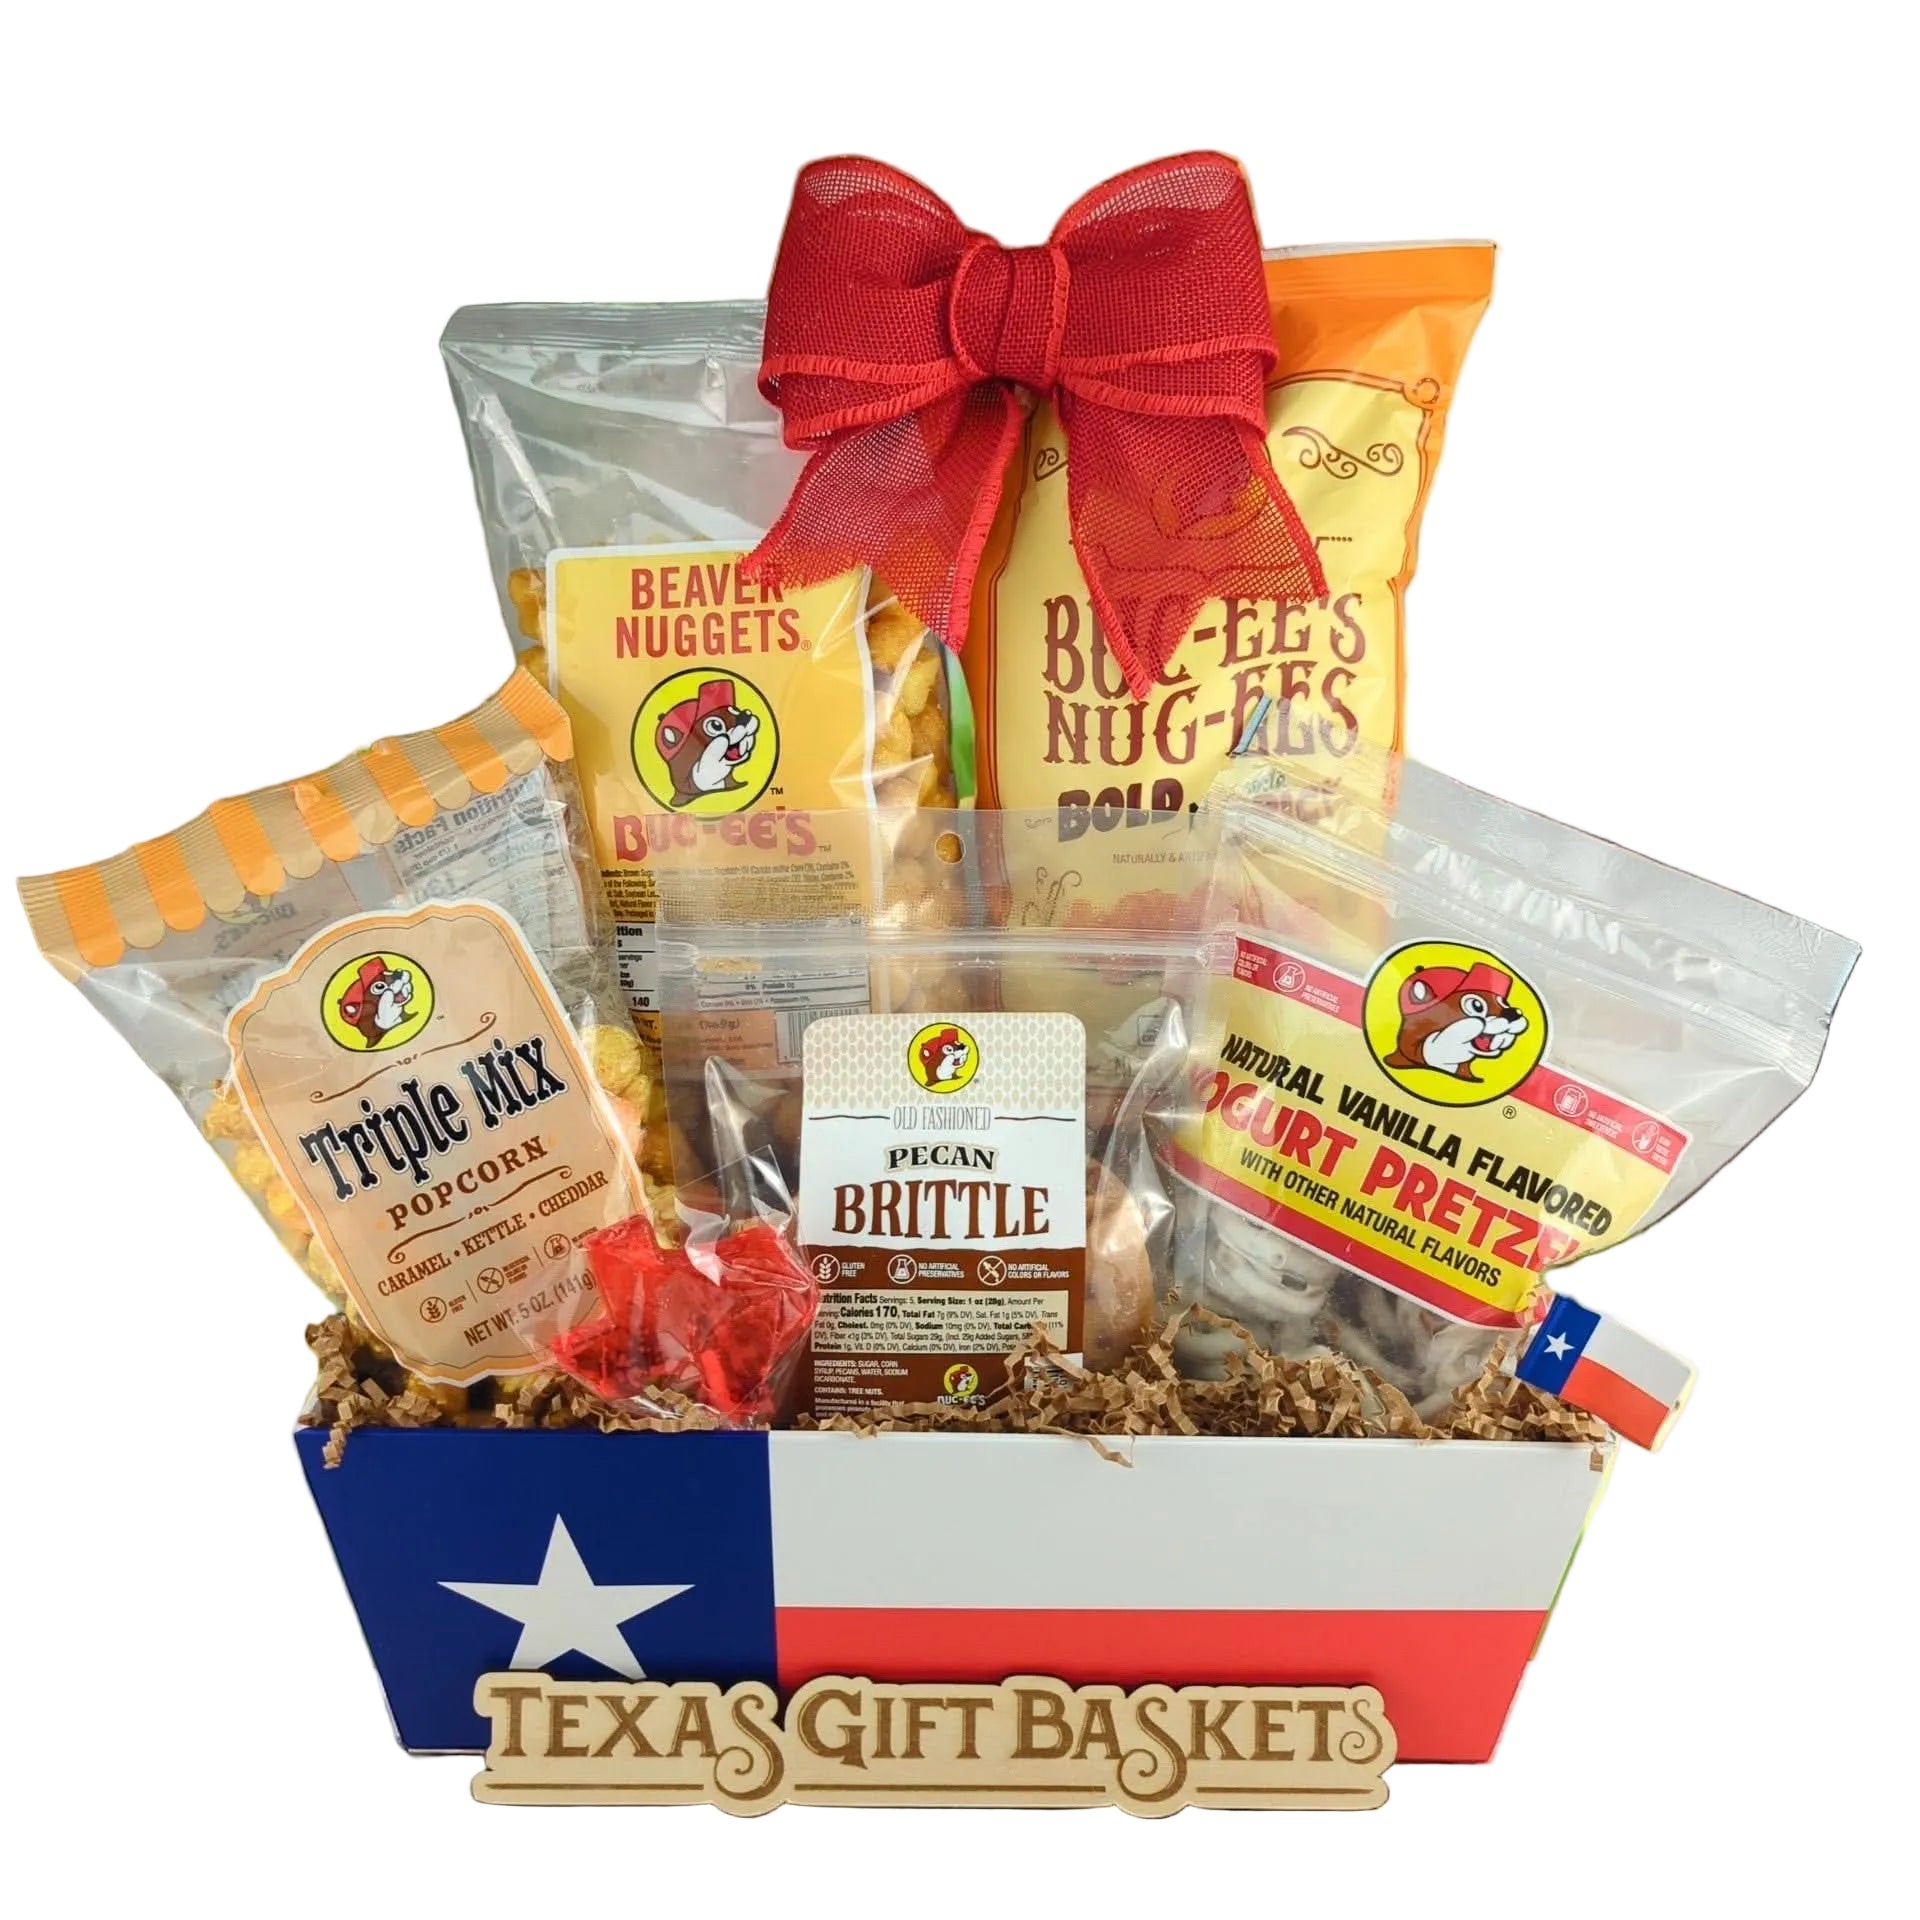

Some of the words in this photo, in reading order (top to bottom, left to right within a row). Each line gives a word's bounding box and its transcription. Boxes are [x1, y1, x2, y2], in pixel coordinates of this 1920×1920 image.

[632, 563, 783, 610] BEAVER
[1042, 661, 1358, 766] NUG-EES
[613, 806, 816, 862] BUC-EE'S
[1058, 778, 1184, 842] BOLD
[1113, 852, 1166, 865] NATURALLY
[632, 997, 649, 1007] 140
[298, 1077, 470, 1200] Triple
[893, 1106, 917, 1130] OLD
[922, 1106, 991, 1131] FASHIONED
[1220, 1034, 1325, 1105] NATURAL
[1337, 1085, 1462, 1168] VANILLA
[1466, 1147, 1613, 1237] FLAVORED
[386, 1135, 549, 1231] POPCORN
[888, 1145, 995, 1170] PECAN
[377, 1253, 452, 1297] CARAMEL
[461, 1212, 528, 1257] KETTLE
[537, 1170, 609, 1217] CHEDDAR
[832, 1179, 1050, 1239] BRITTLE
[1240, 1147, 1284, 1184] WITH
[1284, 1170, 1340, 1211] OTHER
[1340, 1198, 1417, 1251] NATURAL
[1420, 1236, 1502, 1288] FLAVORS
[1360, 1144, 1580, 1273] PRETZE
[822, 1293, 852, 1304] trition
[854, 1293, 878, 1304] Facts
[917, 1296, 946, 1306] Serving
[947, 1296, 966, 1305] Size:
[918, 1270, 965, 1278] PRESERVATIVES
[464, 1319, 493, 1347] NET
[493, 1309, 519, 1332] WT.
[518, 1302, 530, 1320] 5
[530, 1290, 555, 1313] OZ.
[554, 1268, 597, 1301] (141g)
[840, 1307, 874, 1318] Calories
[902, 1310, 921, 1318] Total
[923, 1310, 935, 1318] Fat
[915, 1322, 943, 1330] Sodium
[994, 1322, 1012, 1330] Total
[814, 1342, 841, 1350] Protein
[490, 1687, 785, 1801] TEXAS
[797, 1689, 994, 1770] GIFT
[1010, 1689, 1383, 1802] BASKETS
